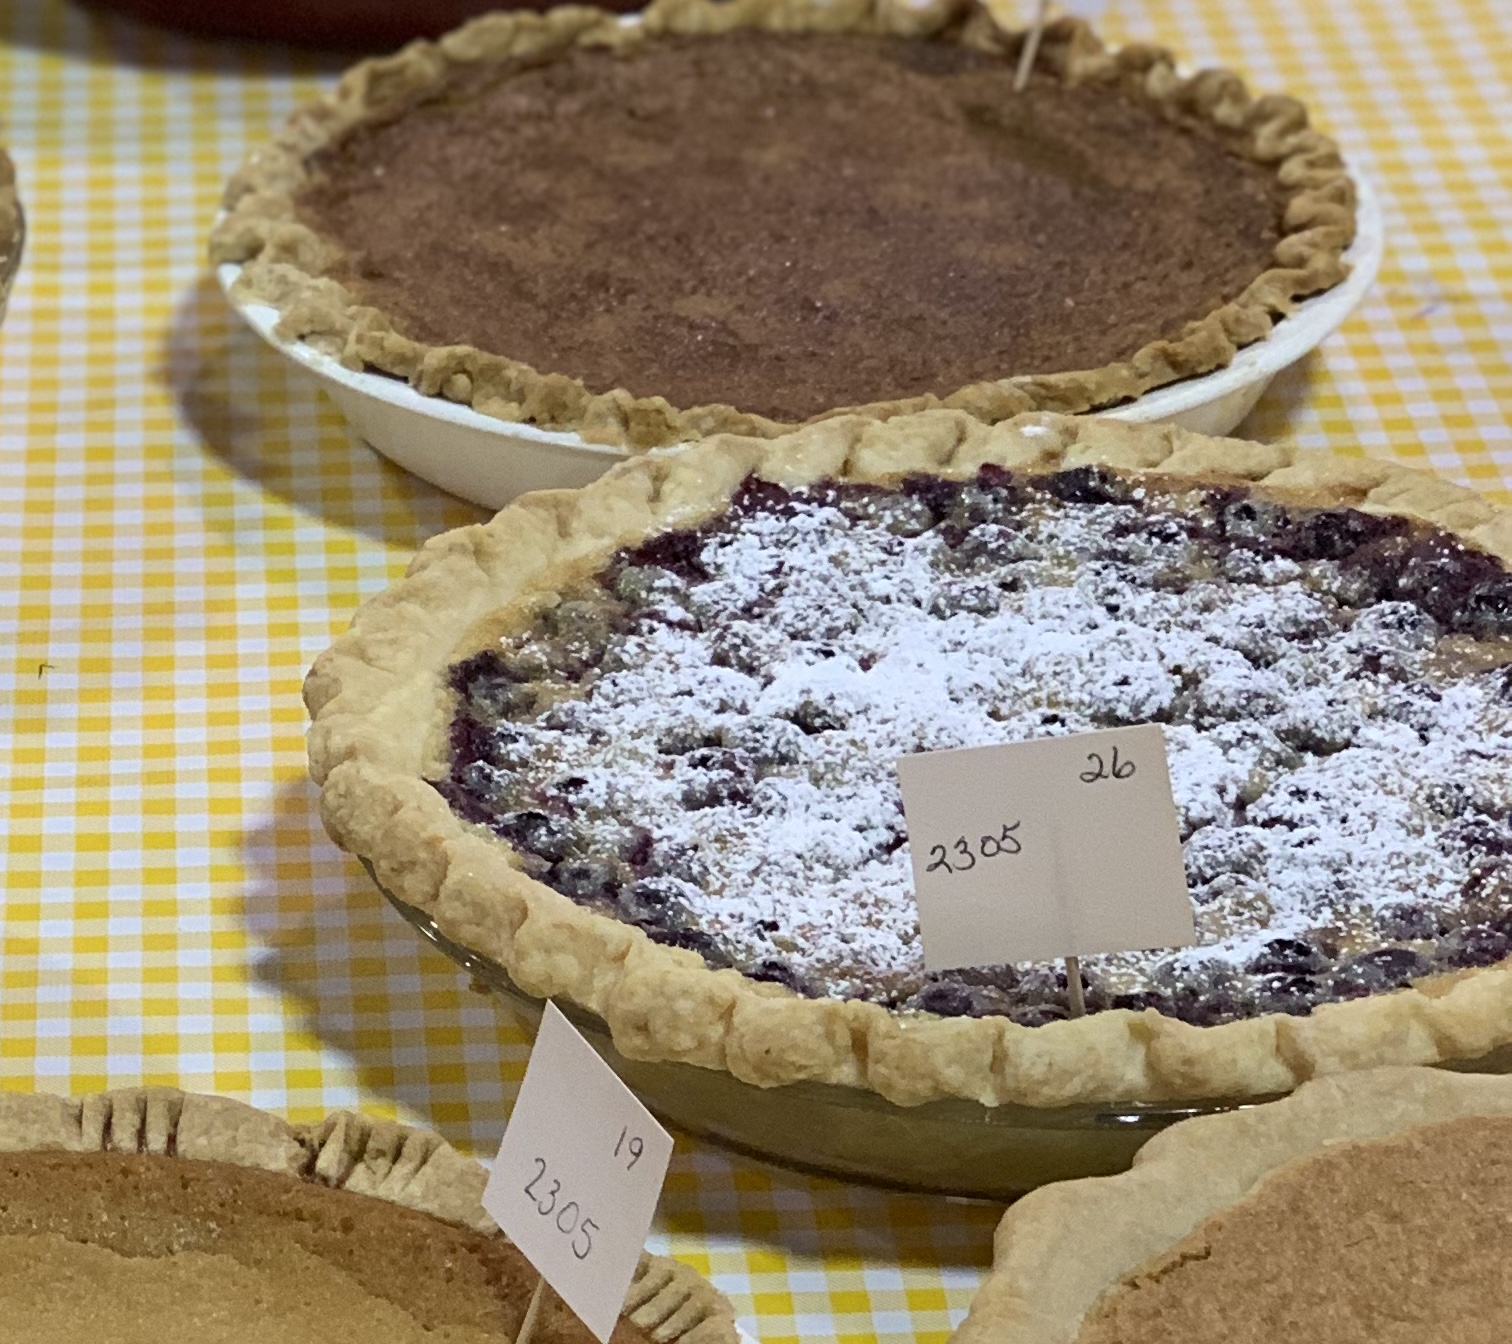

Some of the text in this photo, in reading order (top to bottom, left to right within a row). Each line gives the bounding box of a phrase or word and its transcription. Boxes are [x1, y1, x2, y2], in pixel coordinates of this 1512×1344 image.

[1078, 745, 1136, 784] 26
[925, 820, 1022, 874] 2305
[613, 1125, 645, 1171] 19
[523, 1156, 600, 1260] 2305
